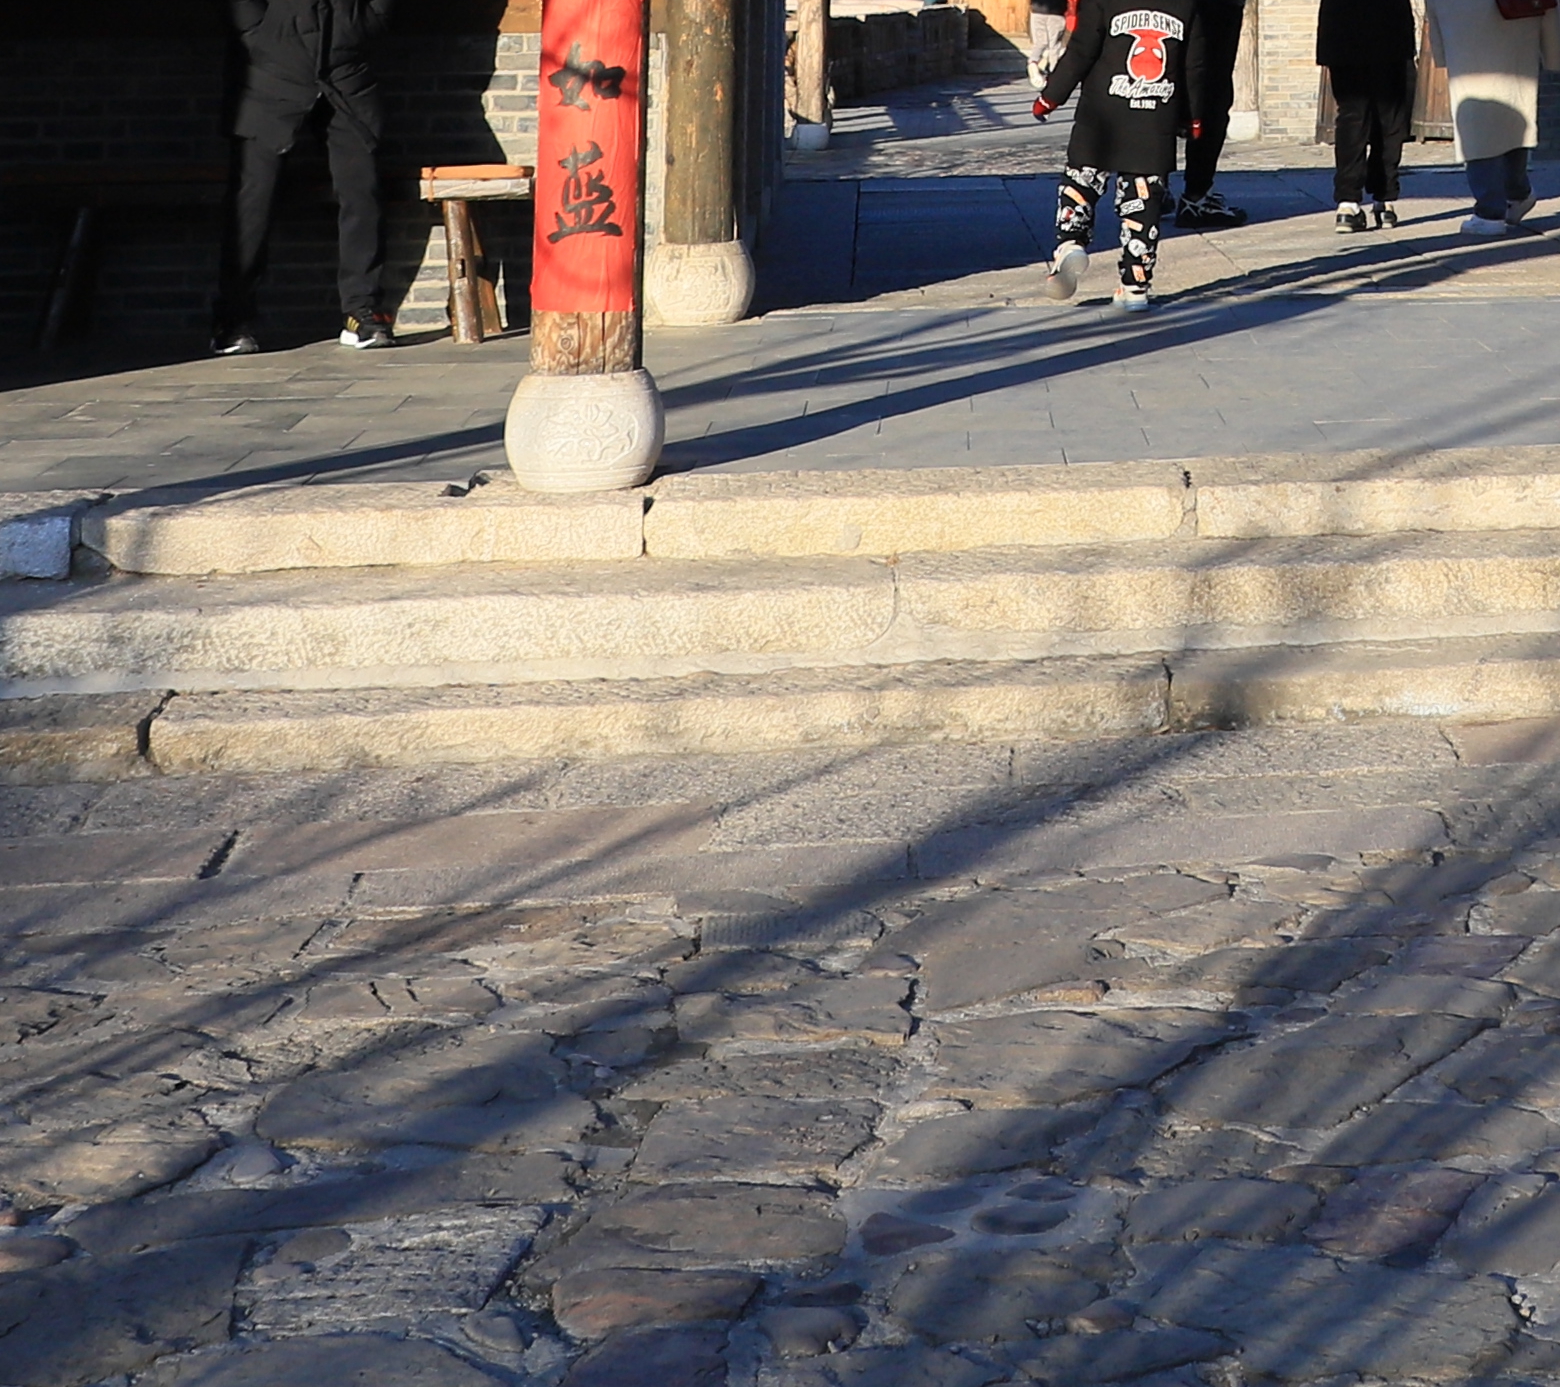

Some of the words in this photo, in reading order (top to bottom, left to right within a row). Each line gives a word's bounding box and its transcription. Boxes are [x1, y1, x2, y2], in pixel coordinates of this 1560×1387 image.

[1113, 12, 1151, 34] SPIDER
[1152, 14, 1182, 39] SENSE
[1130, 77, 1174, 102] Amazing
